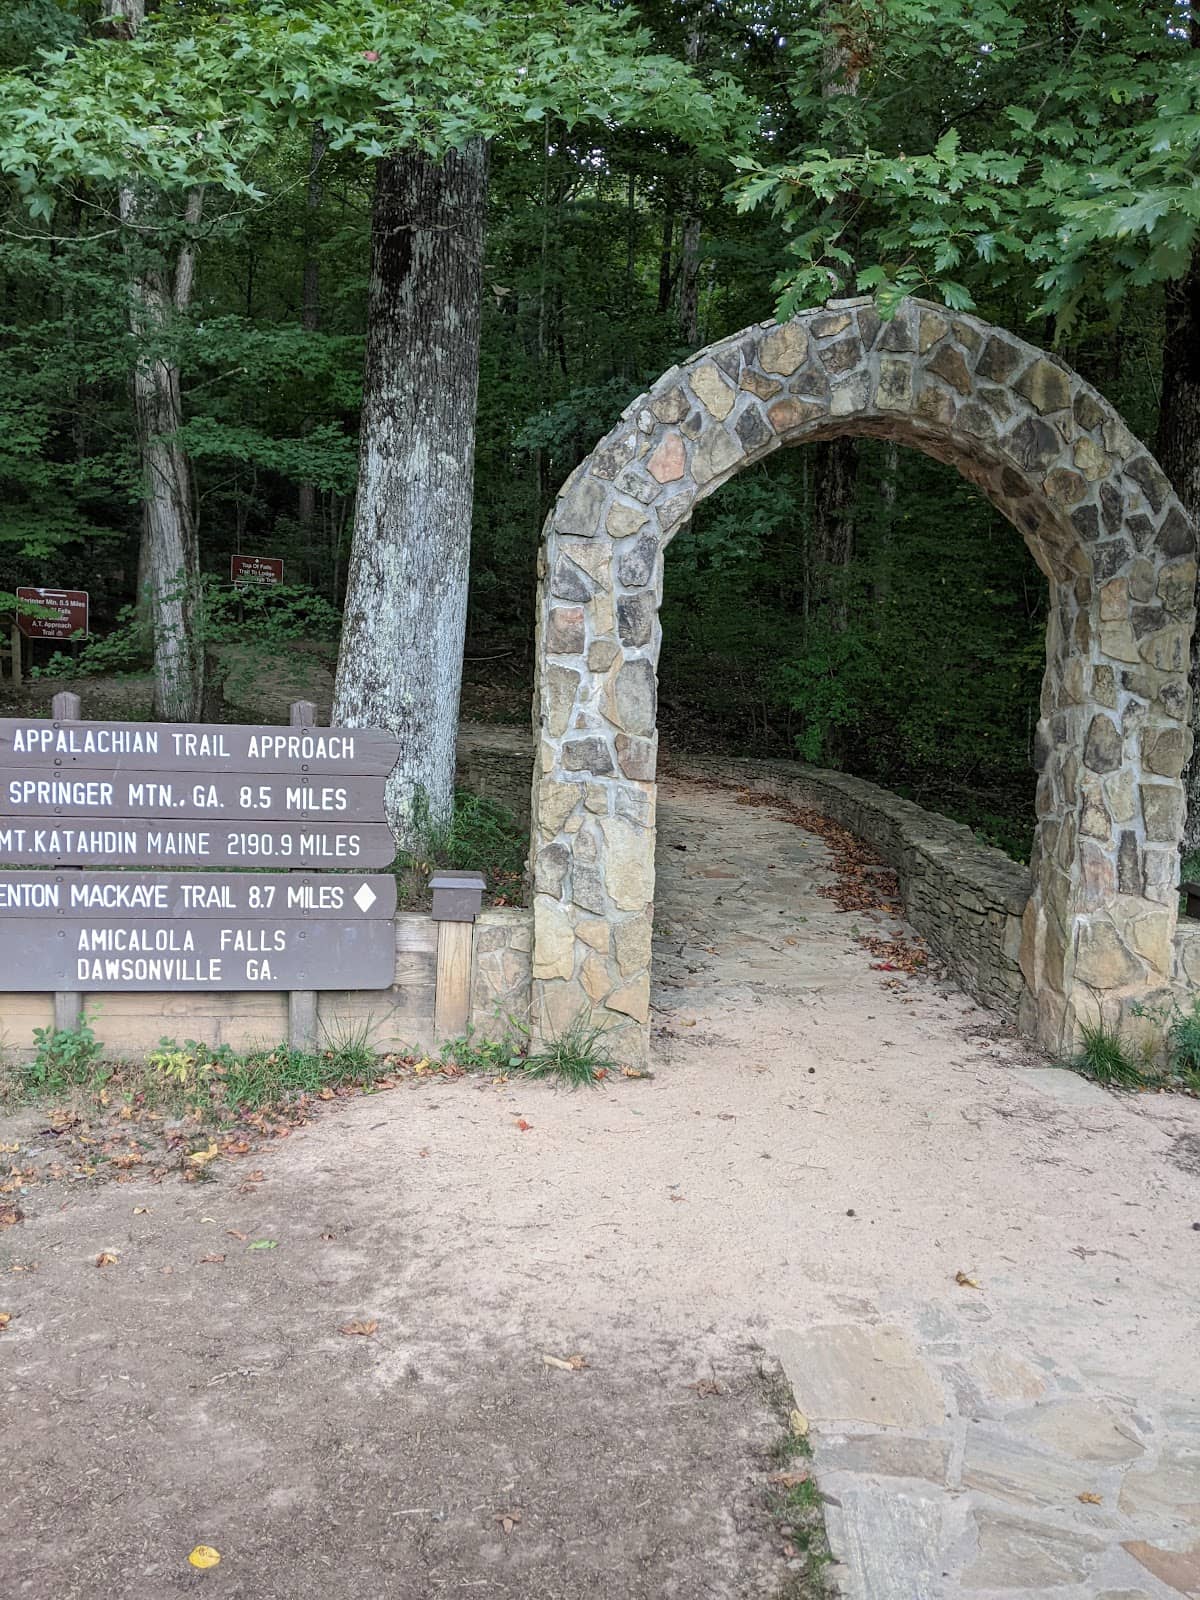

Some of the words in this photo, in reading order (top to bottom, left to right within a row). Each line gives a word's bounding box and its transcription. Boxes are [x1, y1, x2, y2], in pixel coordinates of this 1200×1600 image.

[70, 600, 86, 608] Miles
[44, 621, 72, 629] Approach
[13, 729, 158, 753] APPALACHIAN
[172, 733, 231, 757] TRAIL
[247, 735, 355, 759] APPROACH
[9, 781, 113, 805] SPRINGER
[193, 785, 225, 808] GA.
[239, 786, 272, 809] 8.5
[286, 788, 347, 810] MILES
[147, 832, 210, 855] MAINE
[227, 833, 293, 856] 2190.9
[300, 834, 361, 856] MILES
[70, 884, 169, 909] MACKAYE
[181, 885, 236, 909] TRAIL
[248, 886, 276, 909] 8.7
[287, 886, 344, 909] MILES
[77, 928, 195, 952] AMICALOLA
[220, 929, 287, 952] FALLS
[77, 958, 222, 981] DAWSONVILLE
[246, 958, 279, 981] GA.
